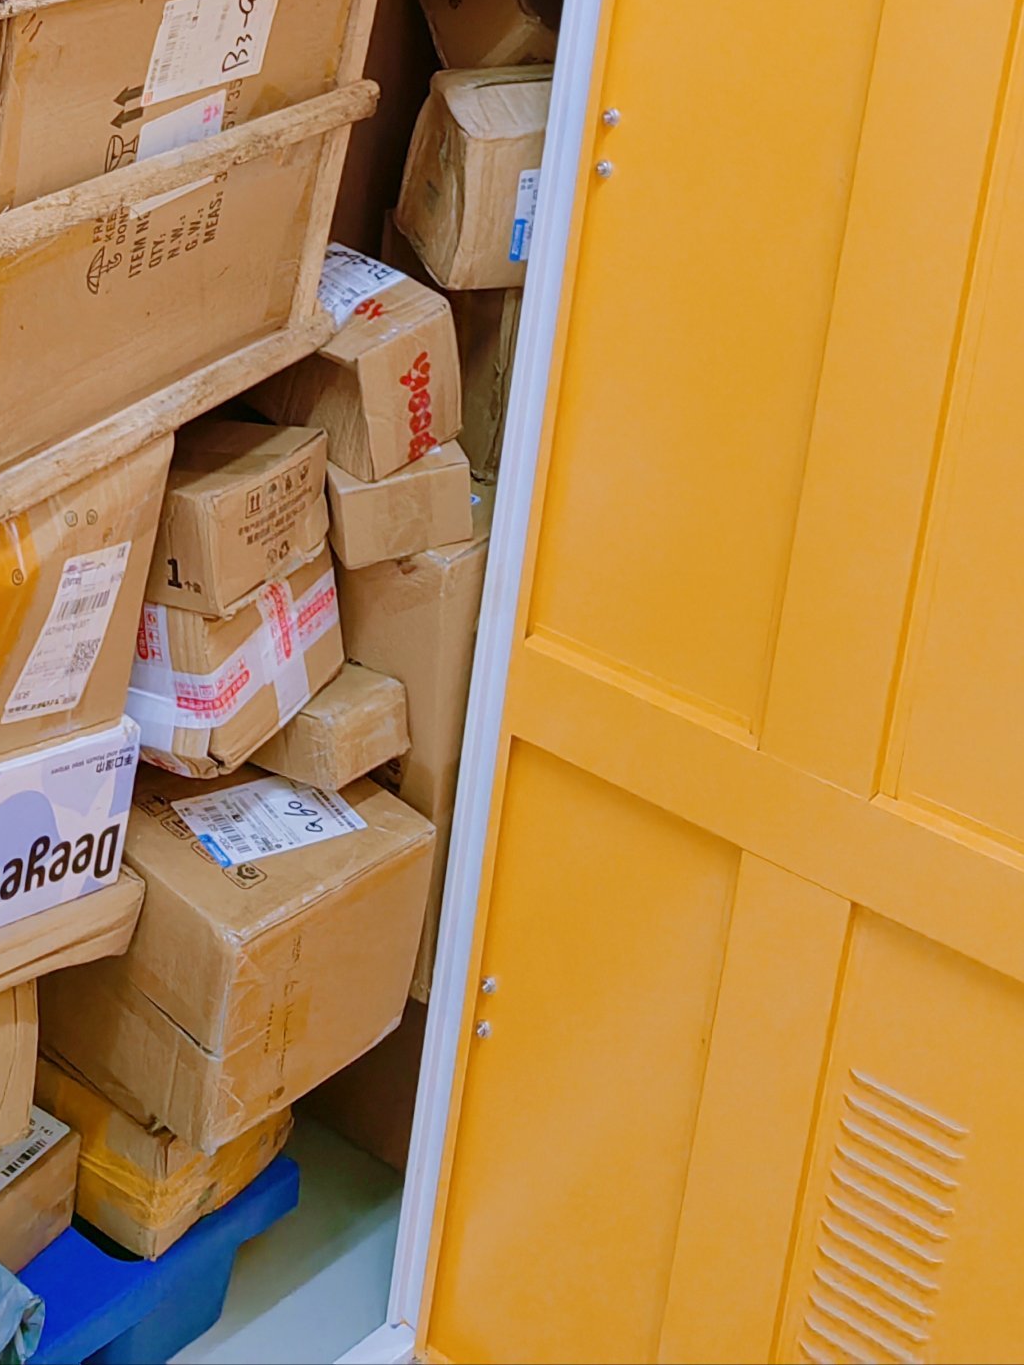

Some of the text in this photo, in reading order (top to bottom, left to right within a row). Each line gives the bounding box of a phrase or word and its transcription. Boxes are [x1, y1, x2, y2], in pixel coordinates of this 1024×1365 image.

[128, 239, 146, 279] ITEM
[166, 558, 183, 589] 1
[283, 800, 324, 833] G60
